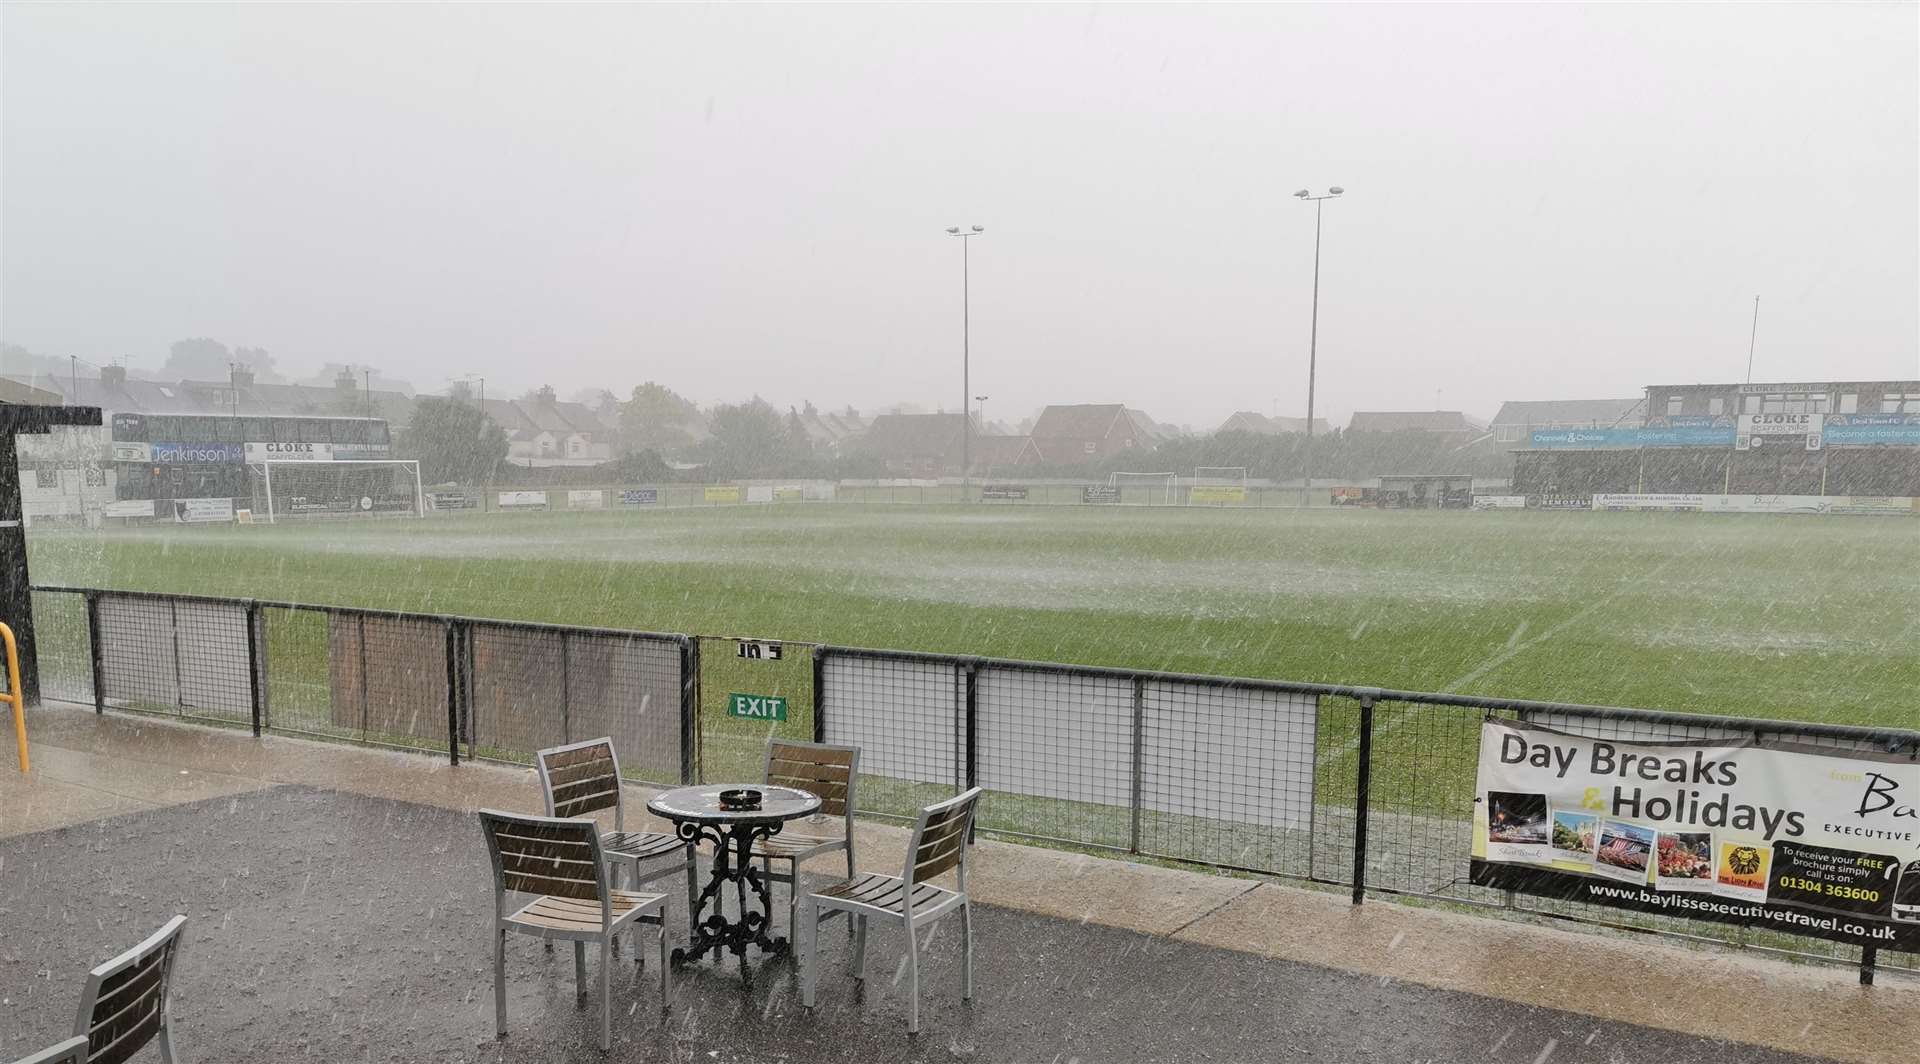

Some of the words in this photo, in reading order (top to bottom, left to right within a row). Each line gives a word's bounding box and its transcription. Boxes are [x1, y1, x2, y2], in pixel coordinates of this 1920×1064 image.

[1752, 415, 1809, 424] CLOKE
[1568, 432, 1577, 443] &
[153, 445, 226, 461] Jenkinson
[265, 443, 313, 452] CLOKE
[736, 697, 781, 717] EXIT
[1500, 733, 1577, 778] Day
[1590, 743, 1738, 786] Breaks
[1830, 770, 1863, 782] from
[1582, 787, 1604, 809] &
[1612, 786, 1805, 840] Holidays
[1824, 823, 1912, 841] EXECUTIVE
[1783, 847, 1793, 855] To
[1796, 849, 1829, 861] receive
[1832, 856, 1855, 867] your
[1857, 858, 1883, 869] FREE
[1793, 858, 1836, 872] brochure
[1838, 865, 1870, 878] simply
[1806, 869, 1822, 878] call
[1824, 873, 1835, 881] us
[1838, 875, 1854, 884] on:
[1731, 876, 1747, 886] LION
[1780, 876, 1822, 893] 01304
[1825, 885, 1879, 902] 363600
[1589, 884, 1896, 941] www.baylissexecutivetravel.co.uk
